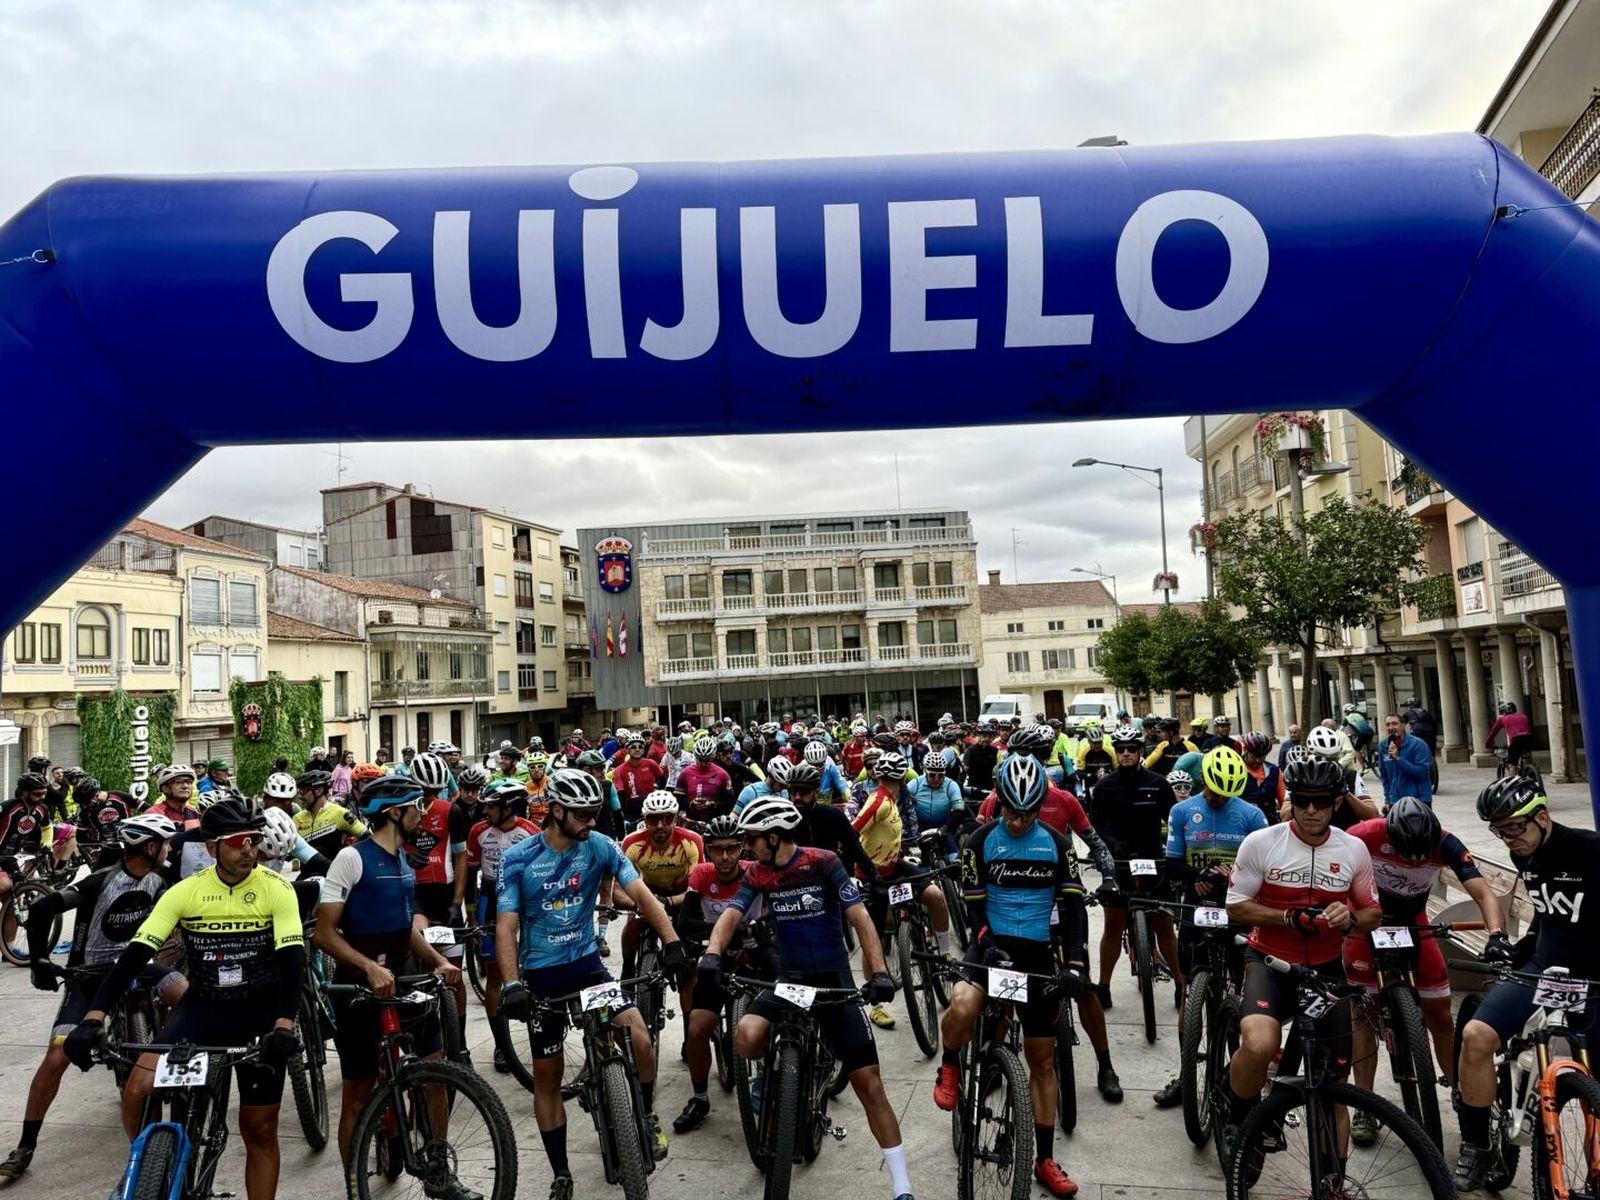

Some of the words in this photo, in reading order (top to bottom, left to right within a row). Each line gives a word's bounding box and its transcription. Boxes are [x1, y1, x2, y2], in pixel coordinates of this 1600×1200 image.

[129, 705, 153, 800] Guijuelo
[891, 887, 910, 899] 232
[1528, 882, 1585, 923] sky
[1540, 987, 1580, 1004] 230
[166, 1060, 202, 1076] 154
[1545, 1134, 1559, 1164] FOX
